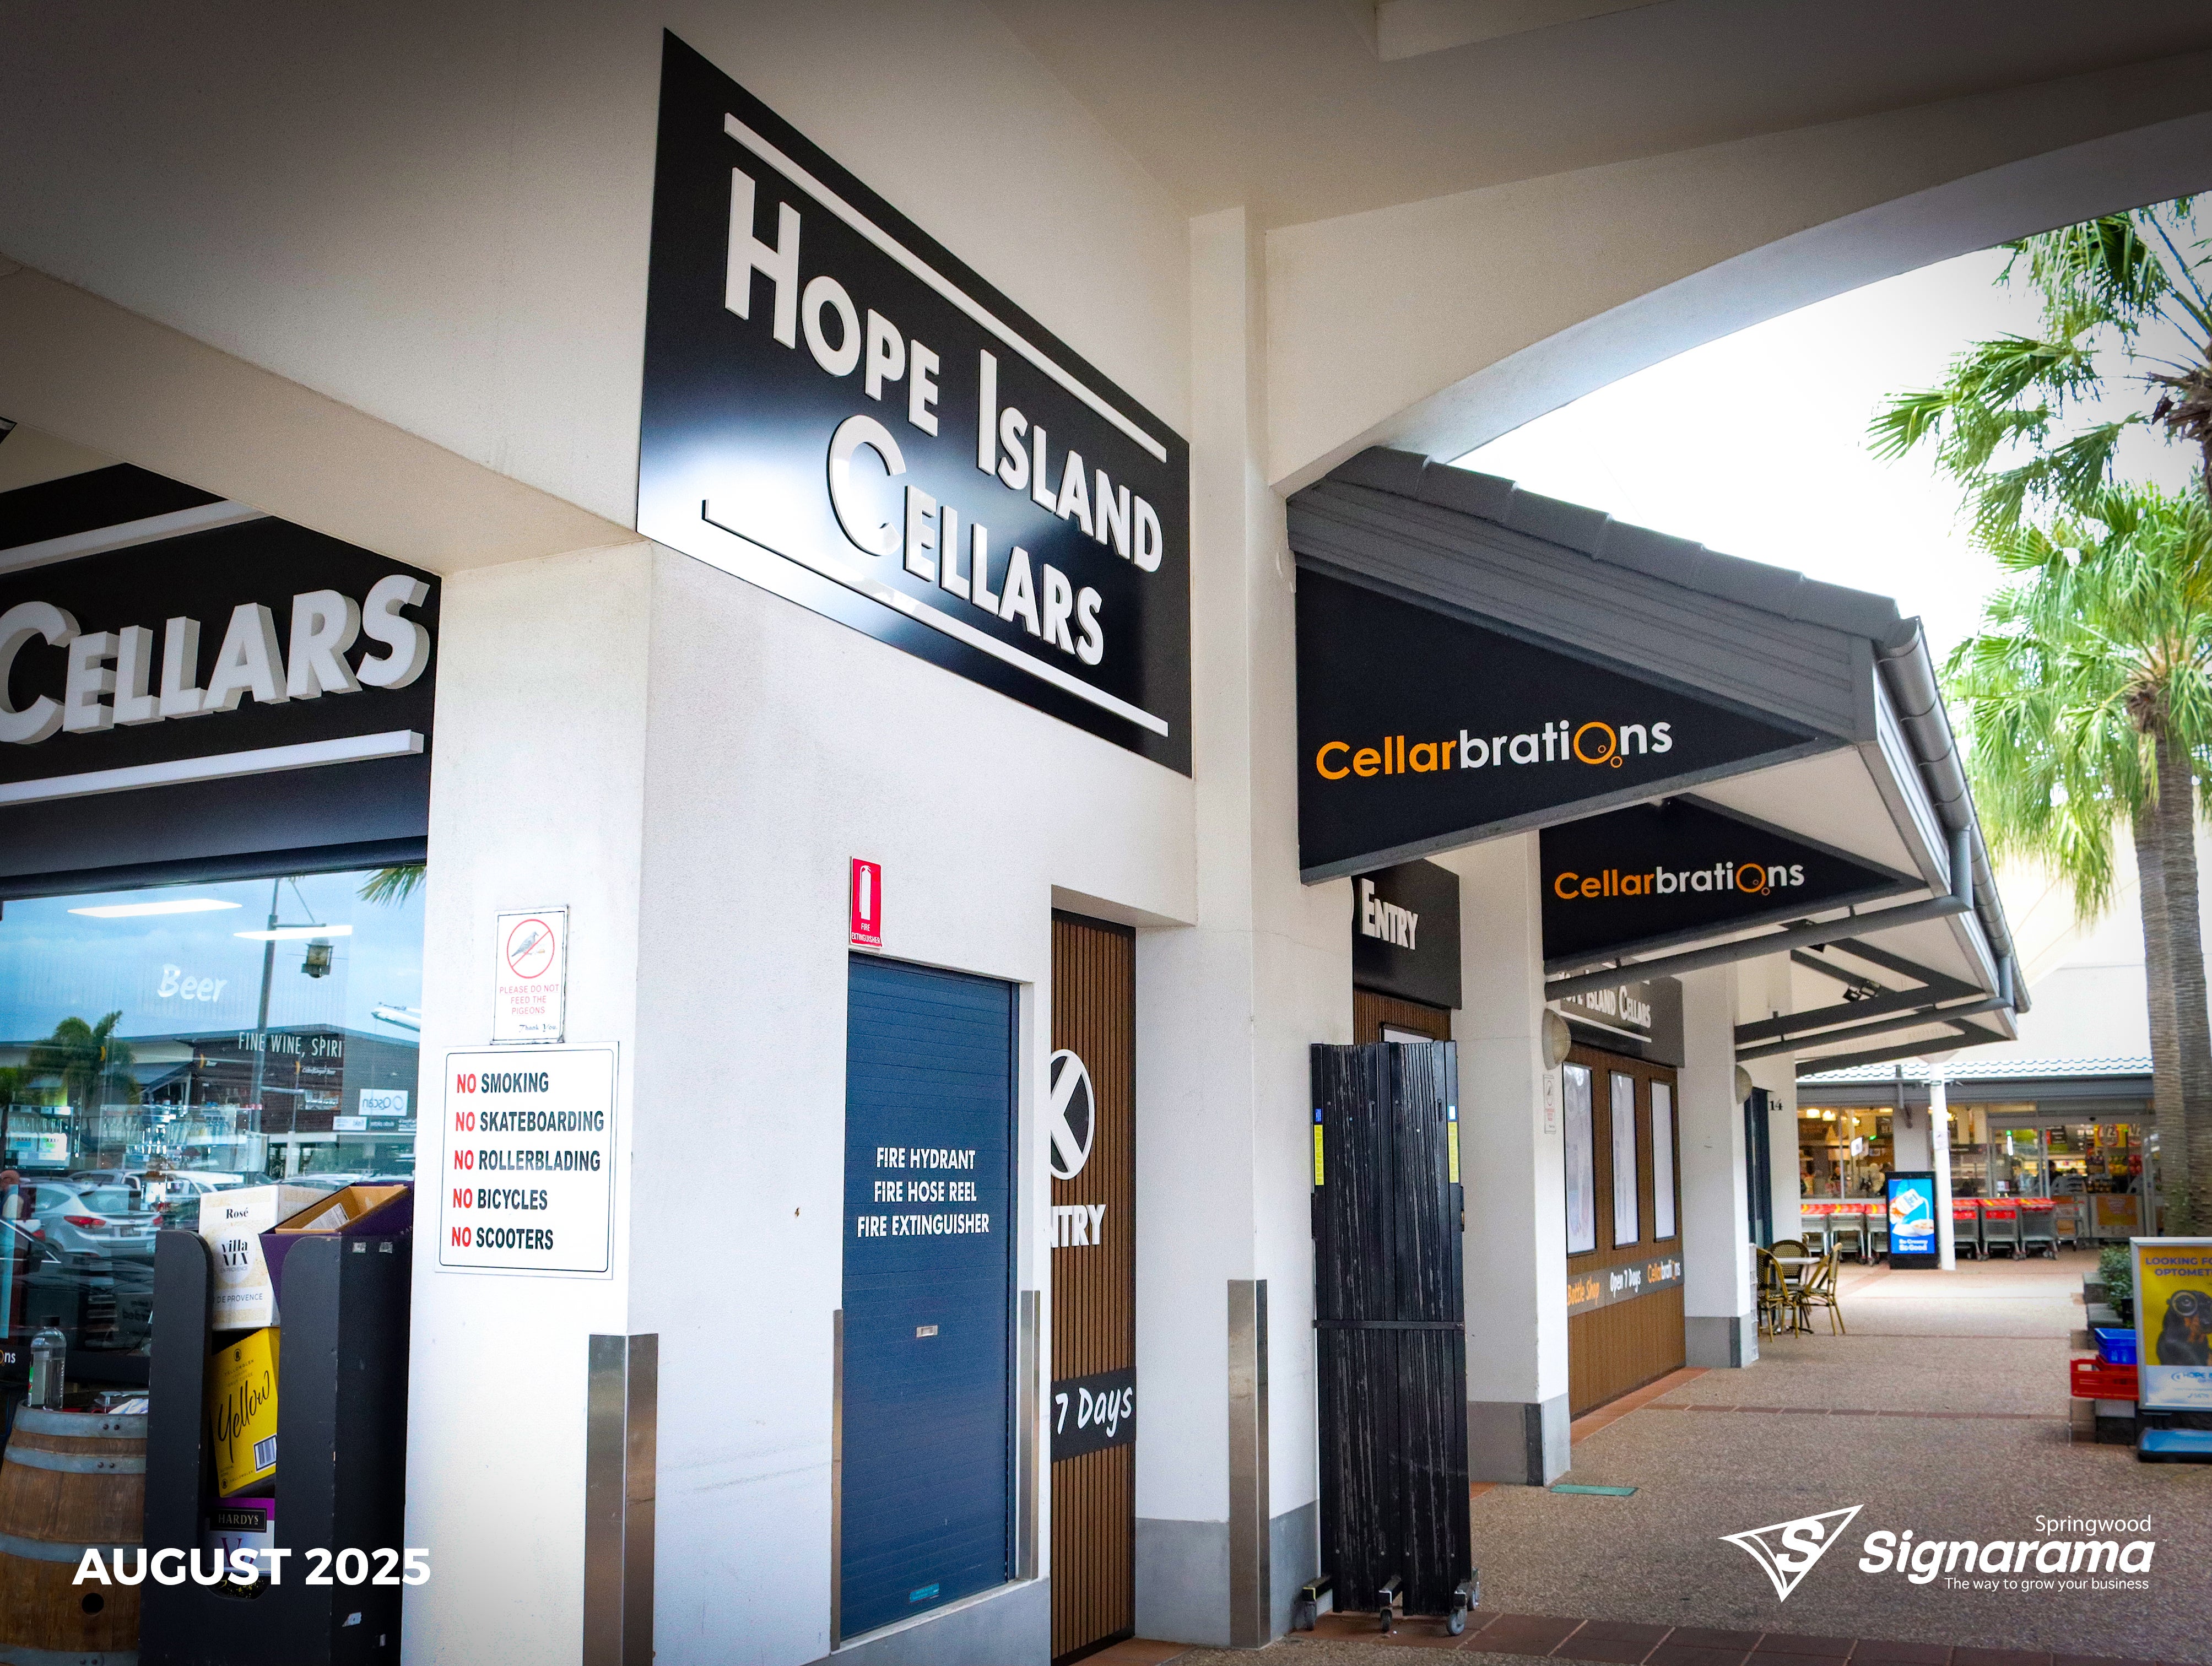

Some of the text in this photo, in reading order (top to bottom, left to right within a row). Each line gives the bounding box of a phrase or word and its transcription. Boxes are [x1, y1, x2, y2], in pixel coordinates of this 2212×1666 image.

[851, 932, 881, 944] EXTINGUISHER
[861, 923, 870, 931] FIRE
[157, 964, 228, 1002] Beer
[500, 986, 528, 994] PLEASE
[512, 1007, 545, 1015] PIGEONS
[519, 1024, 539, 1032] Thank
[239, 1032, 344, 1058] FINE WINE, SPIRI
[457, 1072, 549, 1094] NO SMOKING
[1770, 1099, 1783, 1111] 14
[456, 1111, 604, 1133] NO SKATEBOARDING
[455, 1149, 601, 1171] NO ROLLERBLADING
[877, 1147, 975, 1169] FIRE HYDRANT
[453, 1188, 548, 1210] NO BICYCLES
[874, 1181, 977, 1202] FIRE HOSE REEL
[225, 1207, 248, 1219] Rosé
[857, 1214, 989, 1237] FIRE EXTINGUISHER
[451, 1226, 554, 1250] NO SCOOTERS
[1610, 1272, 1624, 1299] Open
[227, 1293, 263, 1302] PROVENCE
[218, 1370, 270, 1464] Yellow
[1054, 1383, 1133, 1438] 7 Days
